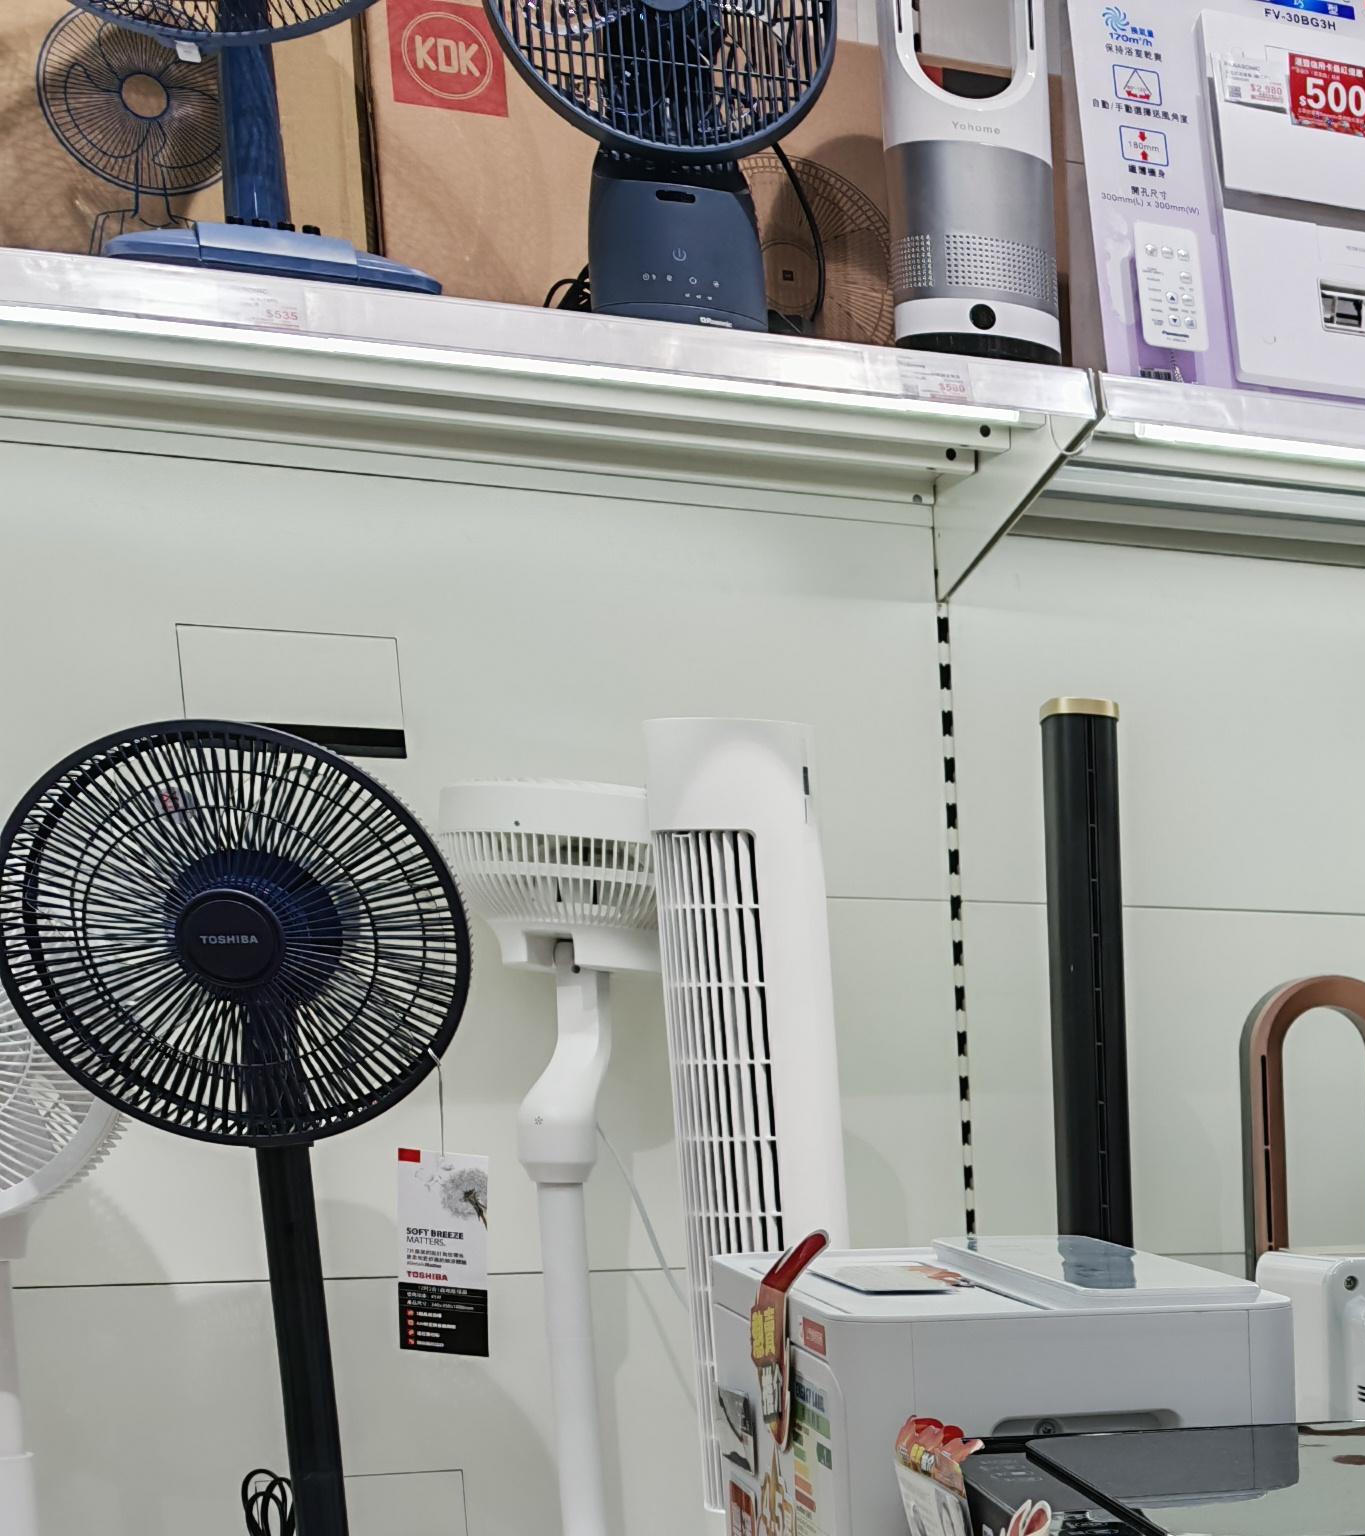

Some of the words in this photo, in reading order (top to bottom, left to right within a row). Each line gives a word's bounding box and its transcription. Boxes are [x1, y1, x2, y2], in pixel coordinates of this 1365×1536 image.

[1264, 8, 1336, 30] FV-30BG3H
[415, 35, 483, 77] KDK
[1131, 186, 1167, 199] 開孔尺寸
[1155, 201, 1199, 215] 300mm(W)
[200, 934, 259, 946] TOSHIBA
[407, 1227, 429, 1237] SOFT
[430, 1229, 464, 1240] BREEZE
[406, 1236, 446, 1247] MATTERS.
[407, 1271, 448, 1281] TOSHIBA
